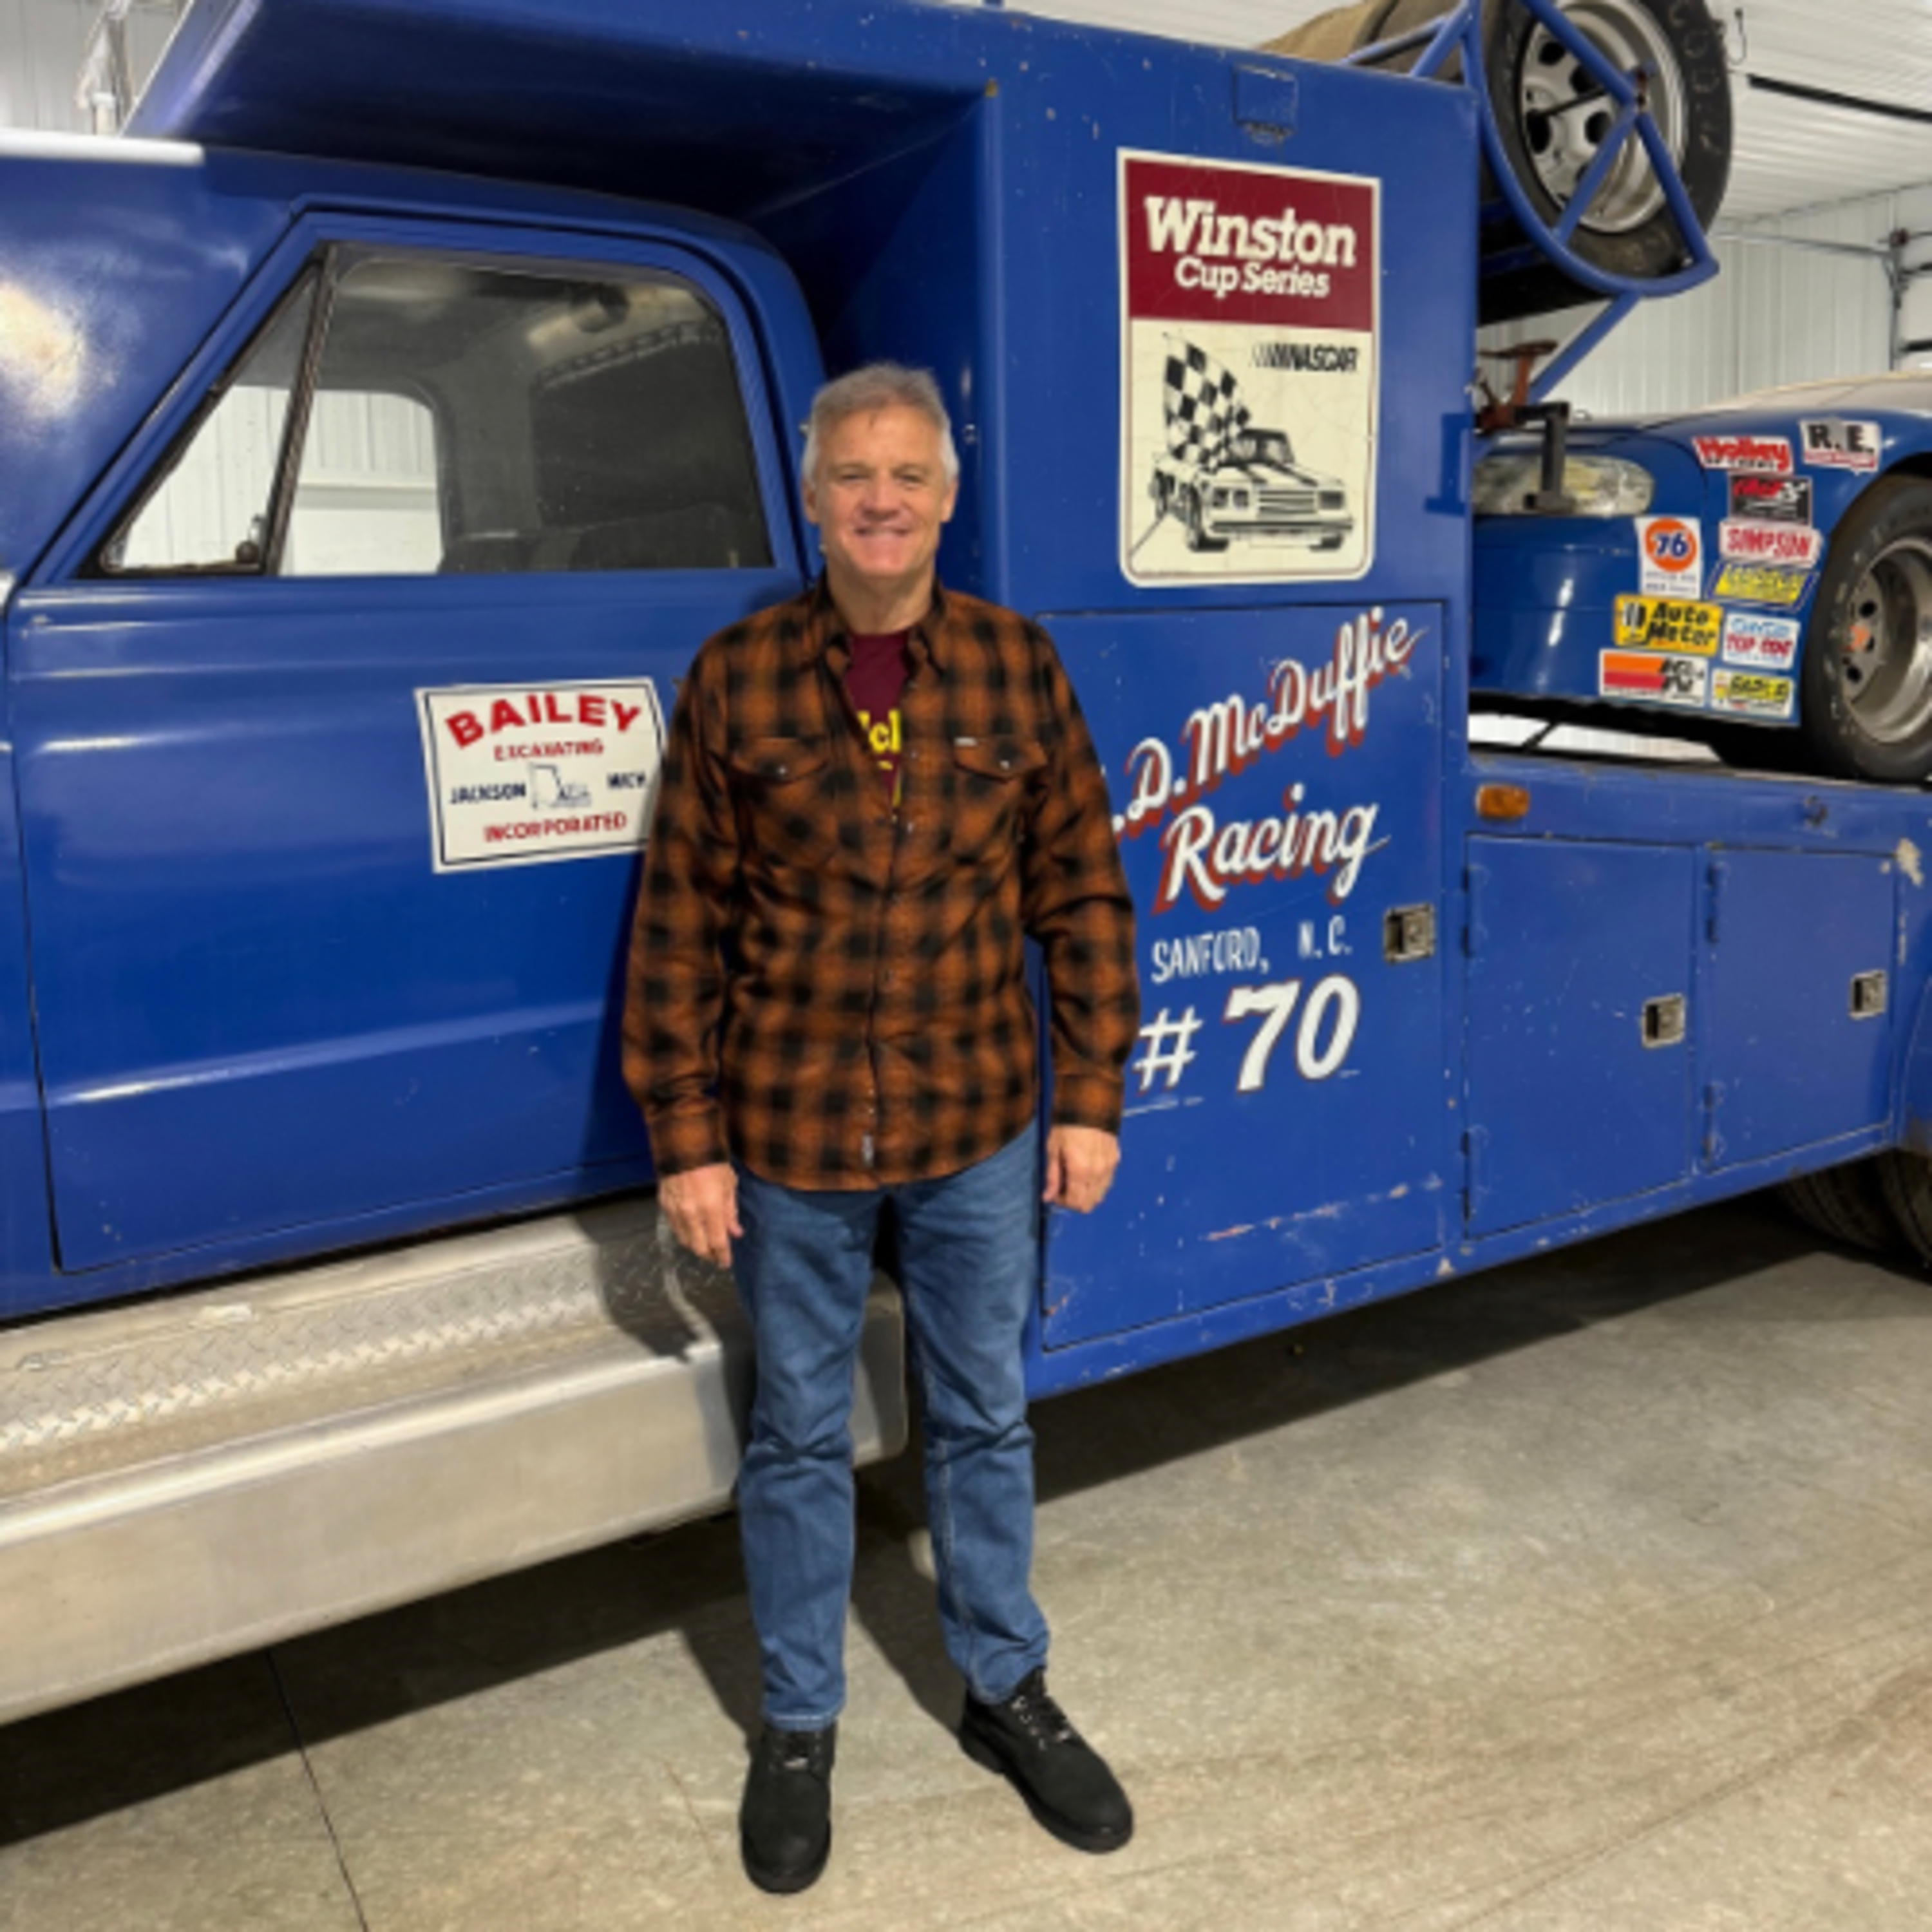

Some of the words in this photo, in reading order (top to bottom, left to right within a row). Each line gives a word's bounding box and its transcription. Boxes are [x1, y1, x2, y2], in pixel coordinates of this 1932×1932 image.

[1144, 195, 1356, 267] Winston
[1175, 256, 1238, 298] Cup
[1241, 261, 1330, 299] Series
[1653, 532, 1689, 560] 76
[1727, 527, 1814, 559] SIMPSON
[1650, 601, 1710, 627] Auto
[1645, 621, 1718, 647] Meter
[445, 692, 641, 750] BAILEY
[1106, 737, 1189, 837] .D.
[1180, 605, 1426, 792] McDuffie
[493, 737, 605, 762] EXCAVATING
[450, 782, 527, 805] JACKSON
[483, 811, 628, 844] INCORPORATED
[1157, 782, 1385, 910] Racing
[1223, 974, 1360, 1094] 70
